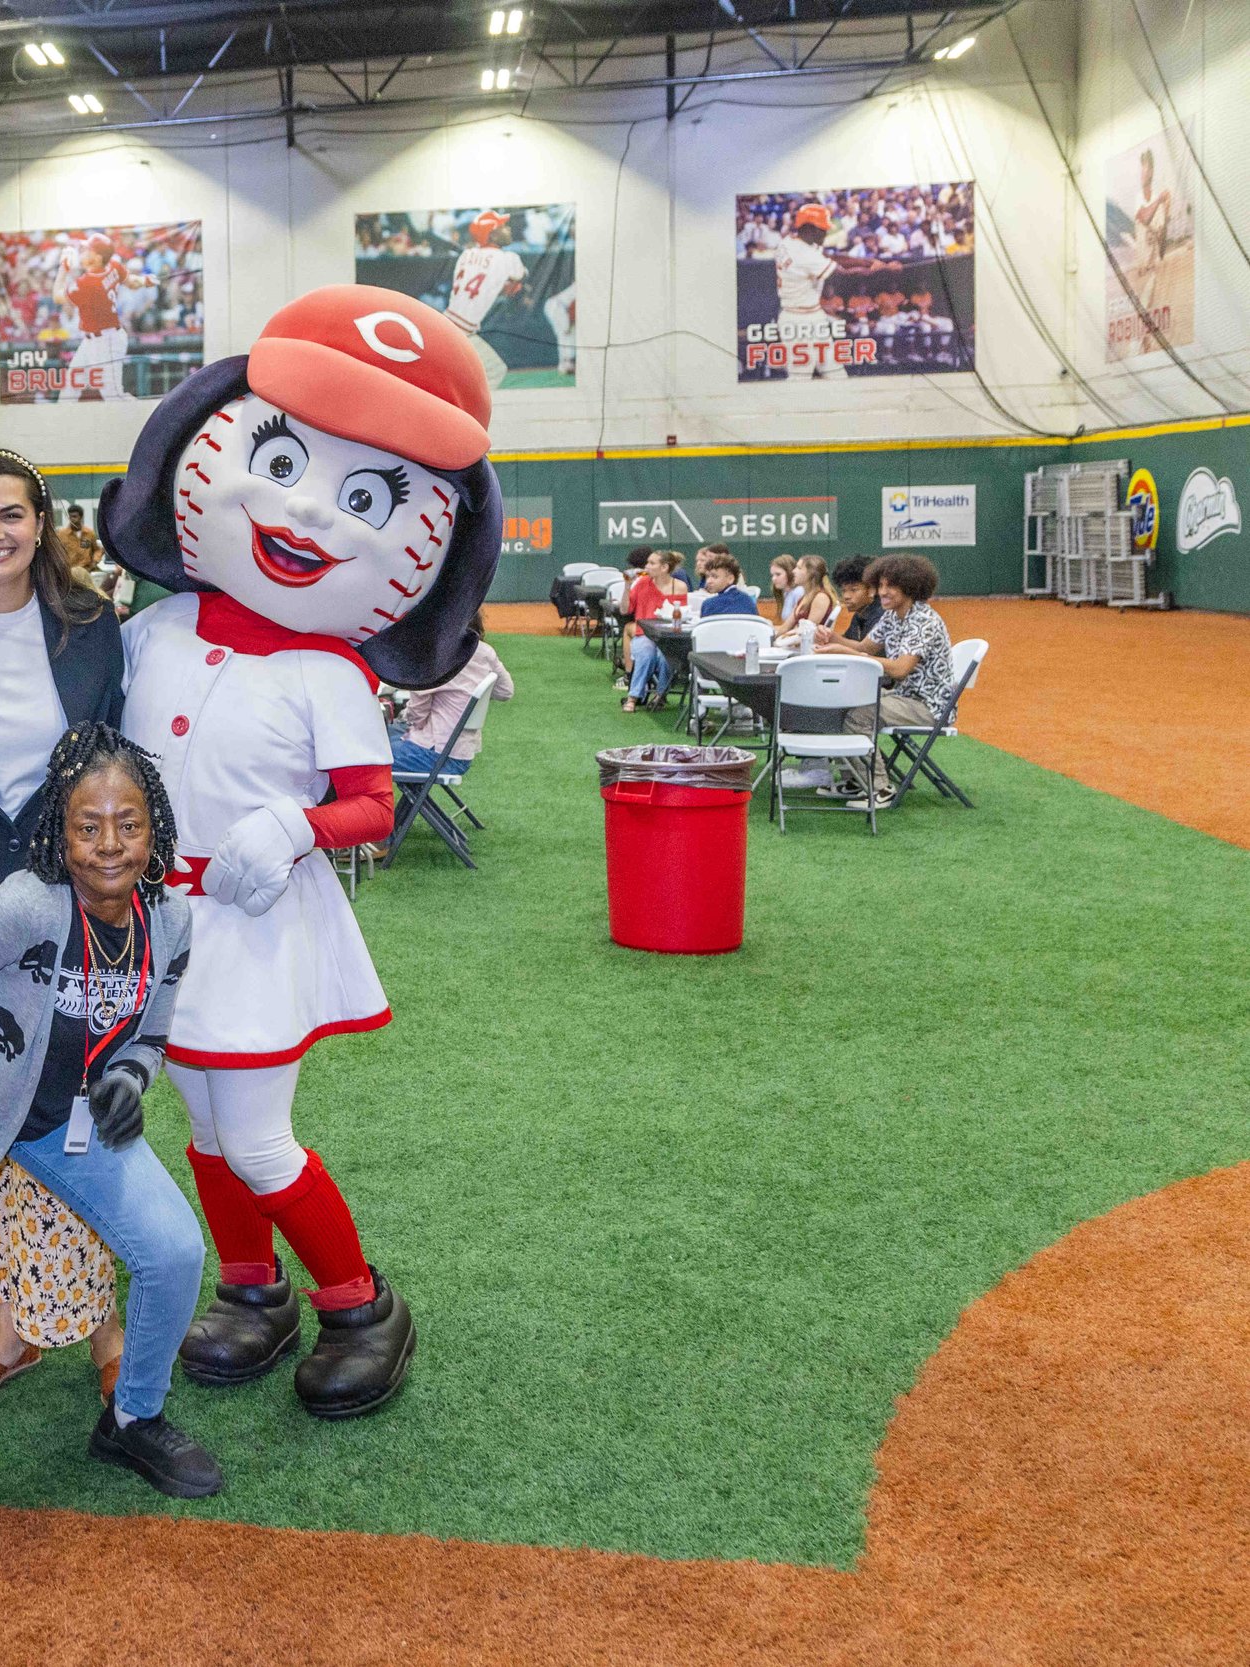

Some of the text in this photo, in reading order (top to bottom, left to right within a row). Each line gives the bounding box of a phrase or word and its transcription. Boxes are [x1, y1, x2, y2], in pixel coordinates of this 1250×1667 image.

[746, 319, 847, 342] GEORGE
[7, 350, 48, 367] JAY
[746, 338, 877, 369] FOSTER
[7, 368, 104, 392] BRUCE
[912, 494, 970, 507] TriHealth
[607, 512, 830, 539] MSA DESIGN
[888, 526, 942, 541] BEACON
[501, 541, 530, 552] NC.
